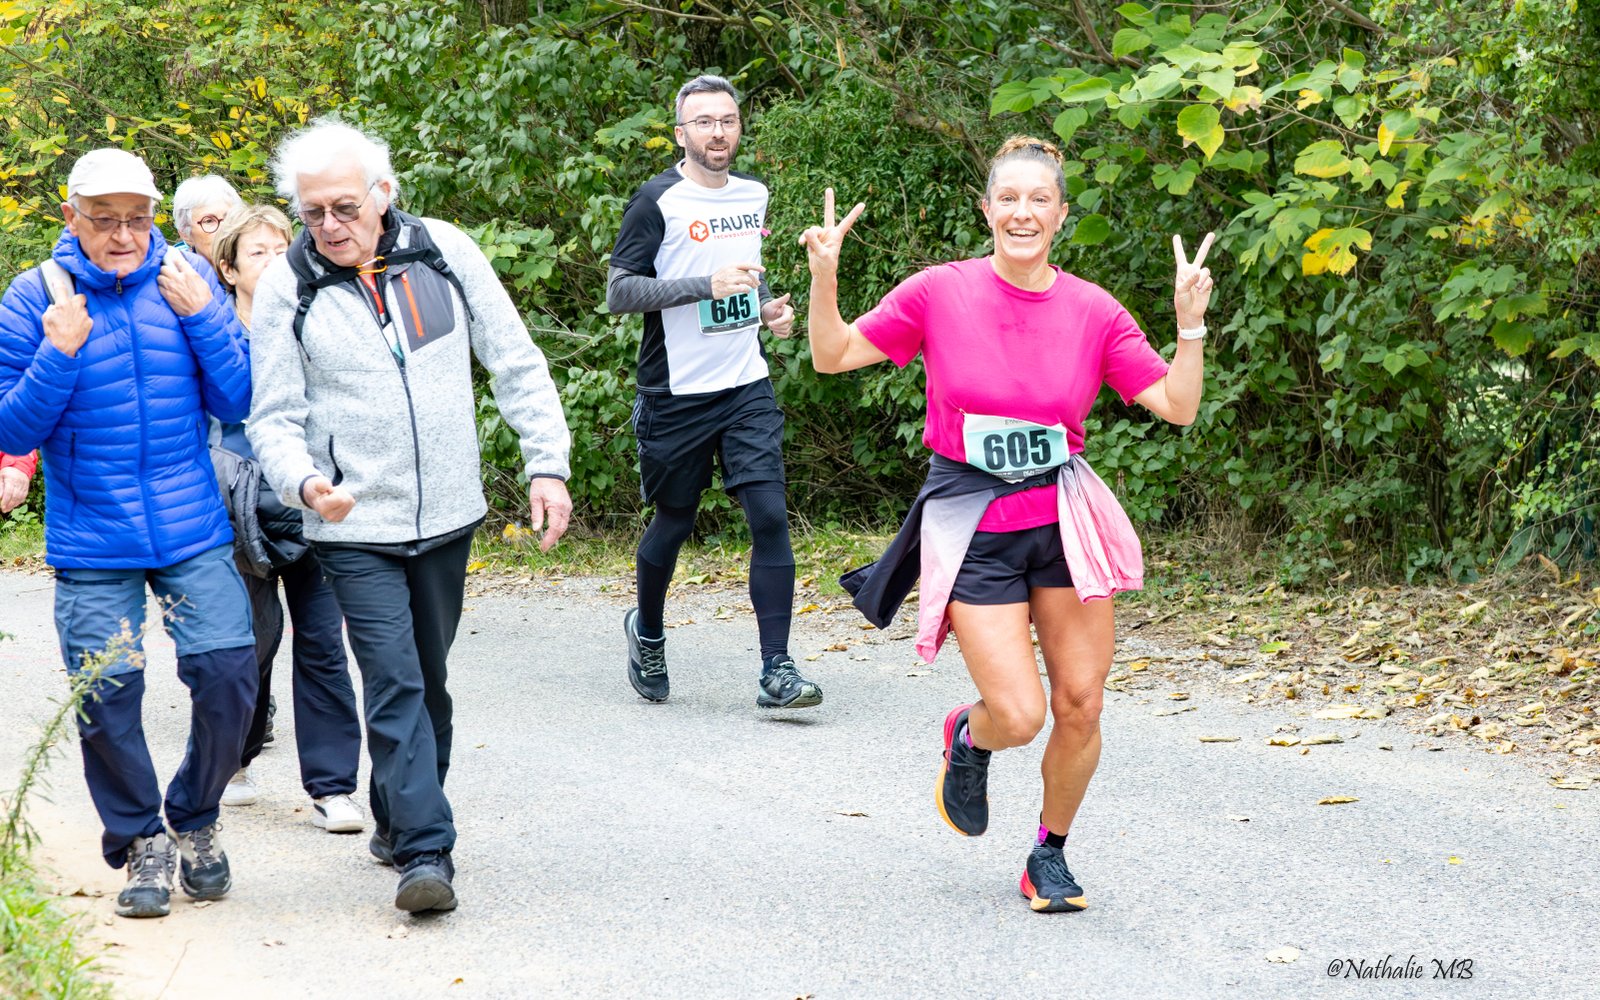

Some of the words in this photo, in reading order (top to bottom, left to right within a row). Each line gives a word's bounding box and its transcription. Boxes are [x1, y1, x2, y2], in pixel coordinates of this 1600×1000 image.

[709, 213, 761, 233] FAURE
[710, 293, 751, 324] 645
[983, 429, 1051, 470] 605
